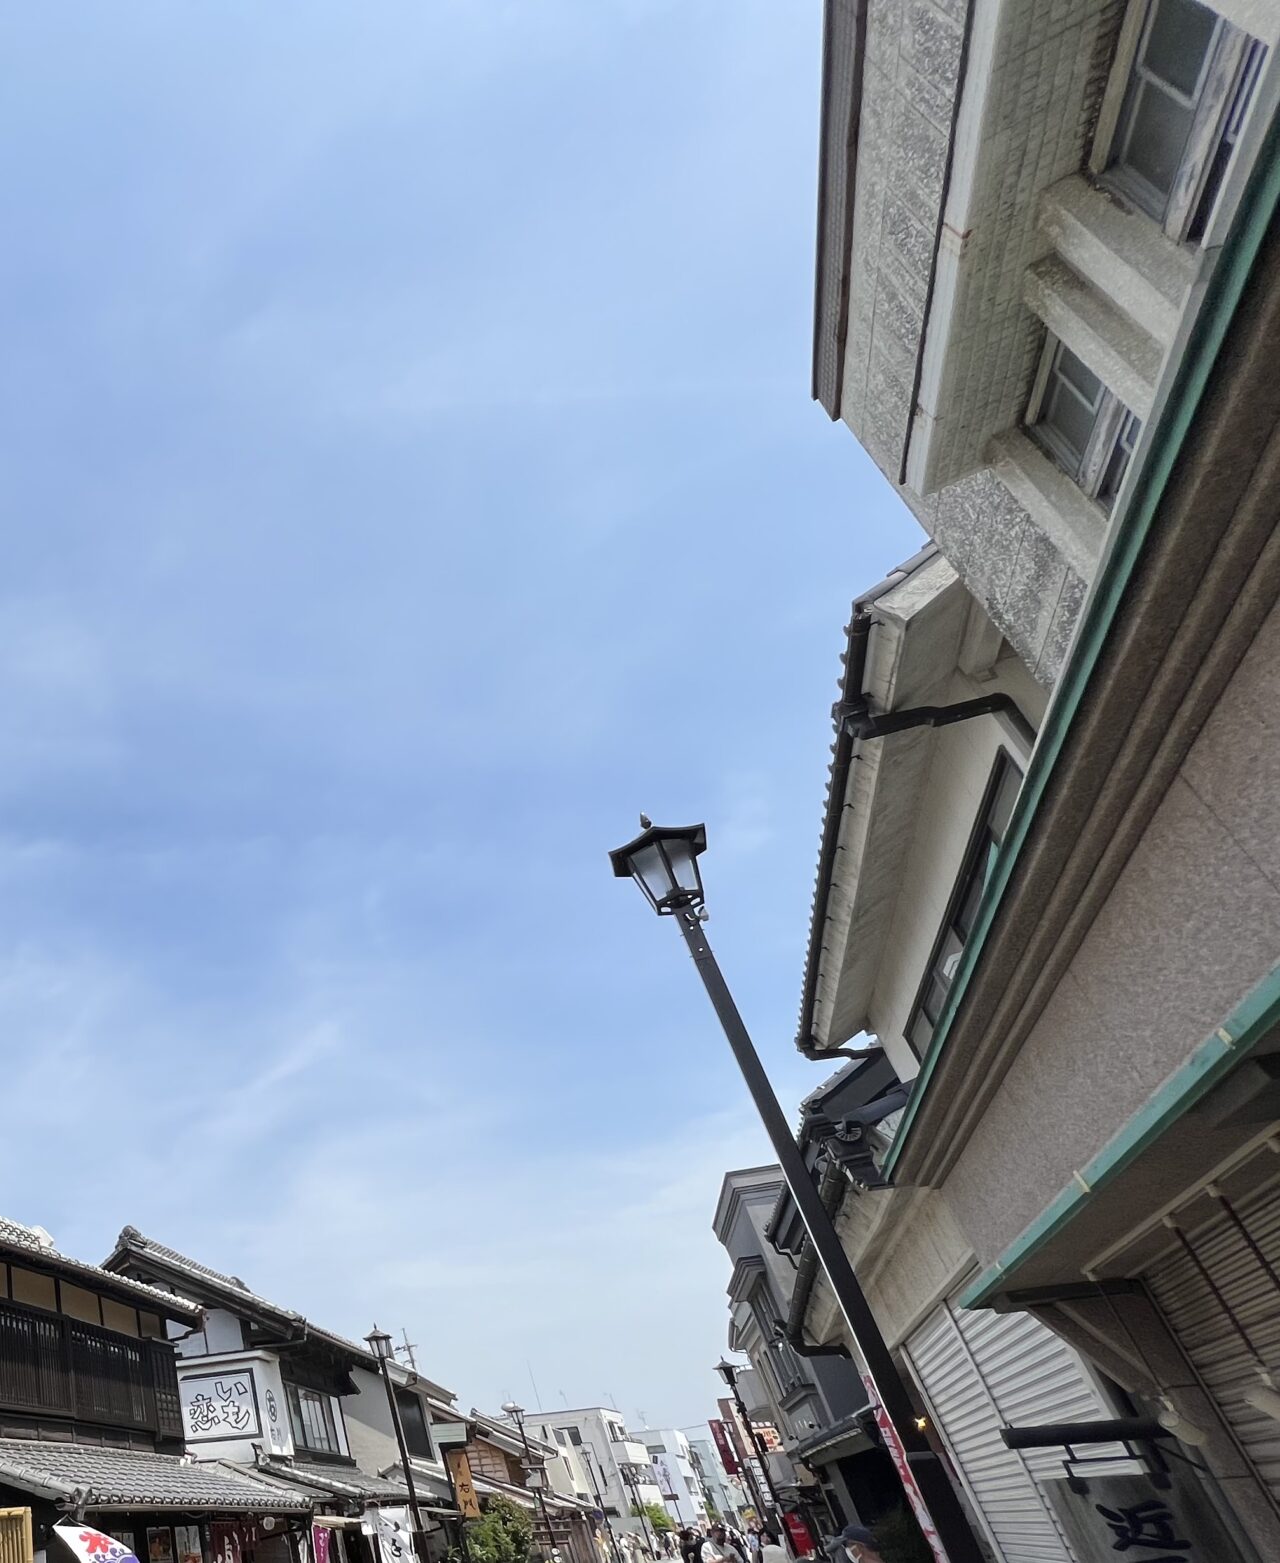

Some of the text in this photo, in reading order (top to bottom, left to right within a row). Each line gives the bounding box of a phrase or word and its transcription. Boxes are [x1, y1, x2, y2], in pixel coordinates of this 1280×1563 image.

[189, 1393, 221, 1433] 恋
[215, 1381, 250, 1430] いも
[1095, 1501, 1192, 1563] 近
